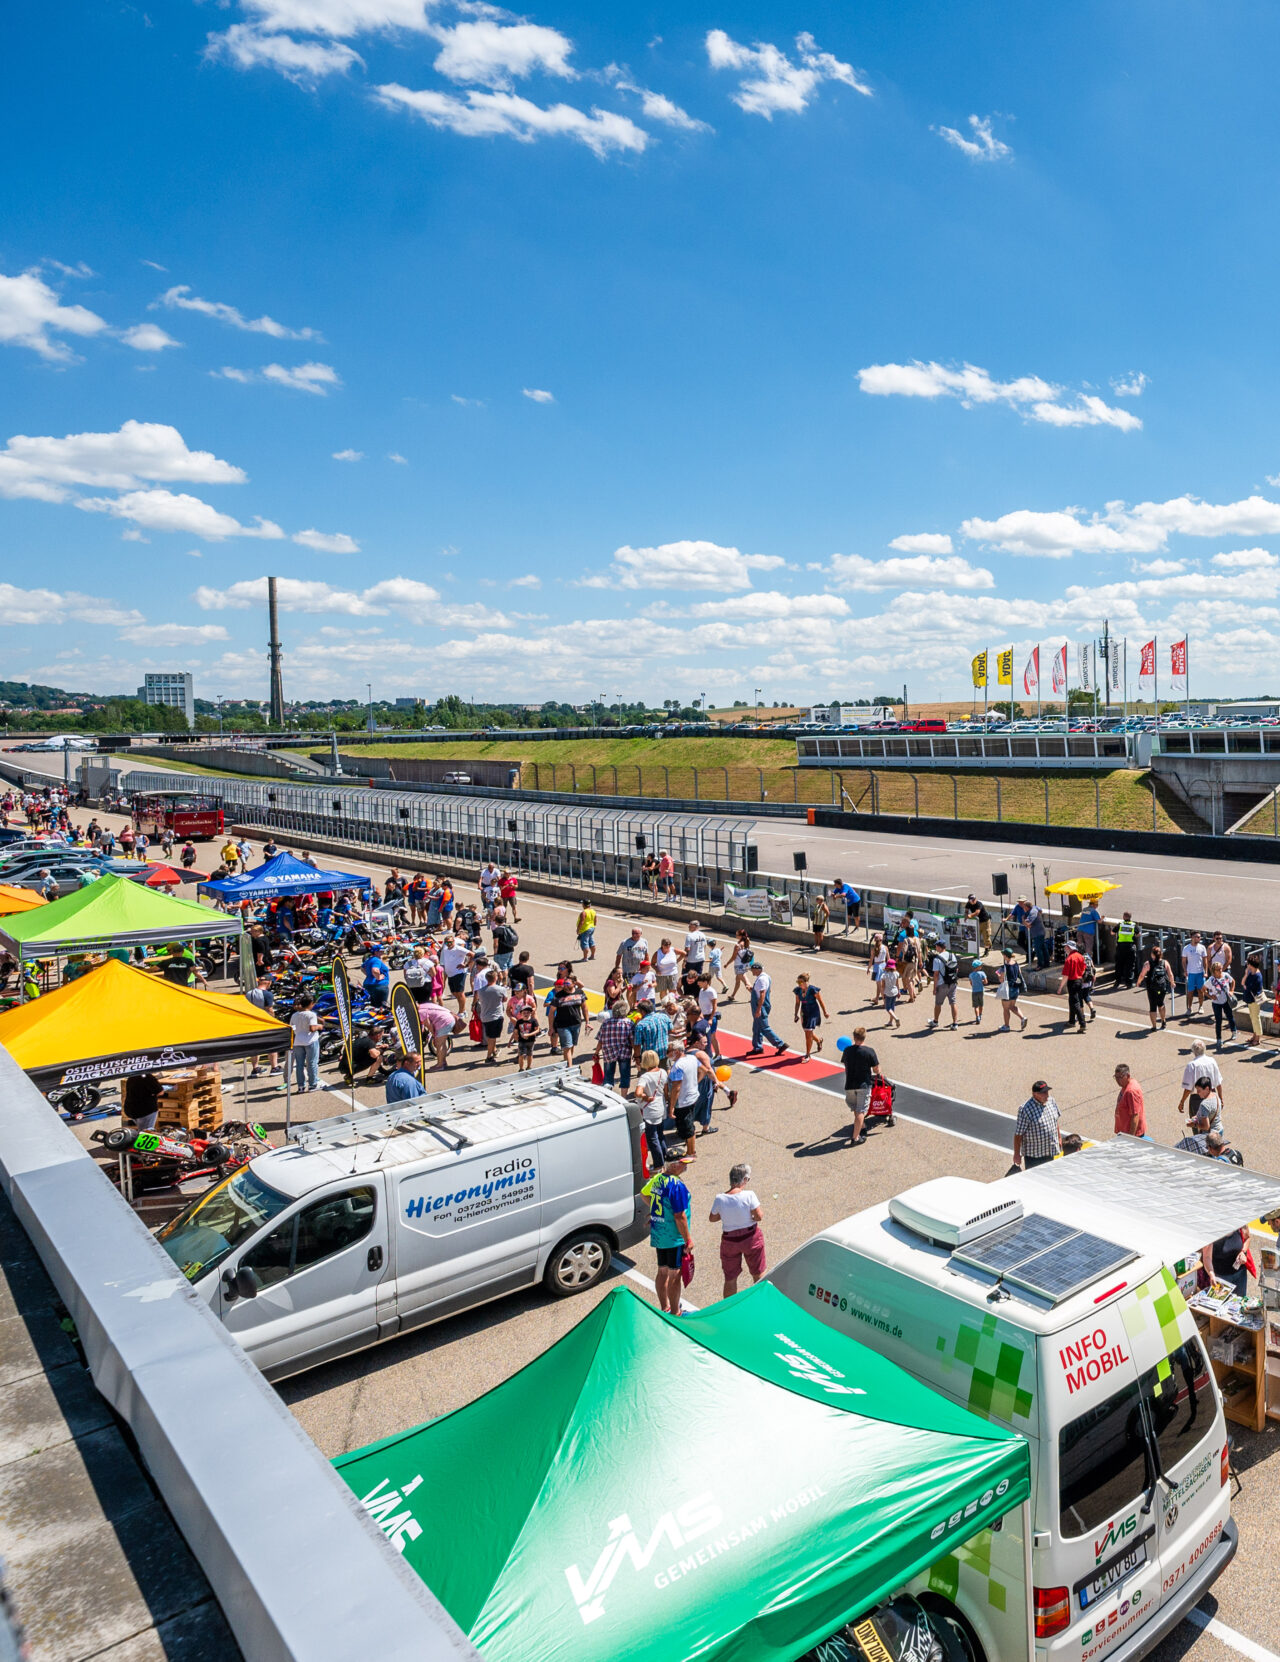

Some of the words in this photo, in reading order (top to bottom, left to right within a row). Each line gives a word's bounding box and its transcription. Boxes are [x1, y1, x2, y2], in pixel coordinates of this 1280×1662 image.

[248, 887, 279, 897] YAMAHA
[276, 872, 322, 881] YAMAHA
[65, 1055, 149, 1076] OSTDEUTSCHER
[65, 1073, 98, 1084] ADAC
[99, 1066, 127, 1077] KART
[129, 1062, 151, 1071] CUP
[136, 1134, 156, 1149] 36
[484, 1157, 533, 1180] radio
[405, 1168, 536, 1218] Hieronymus
[433, 1212, 452, 1222] Fon
[457, 1198, 492, 1214] 037203
[501, 1185, 535, 1200] 549935
[454, 1192, 535, 1223] iq-hieronymus.de
[850, 1306, 903, 1339] www.vms.de
[1058, 1328, 1107, 1370] INFO
[1065, 1343, 1130, 1395] MOBIL
[653, 1514, 769, 1590] GEMEINSAM
[769, 1484, 828, 1524] MOBIL
[1094, 1513, 1137, 1566] VMS
[564, 1490, 724, 1626] VMS
[1092, 1579, 1101, 1594] C
[1081, 1598, 1154, 1662] Servicenummer:
[1162, 1563, 1185, 1593] 0371
[857, 1621, 896, 1662] MOLAND
